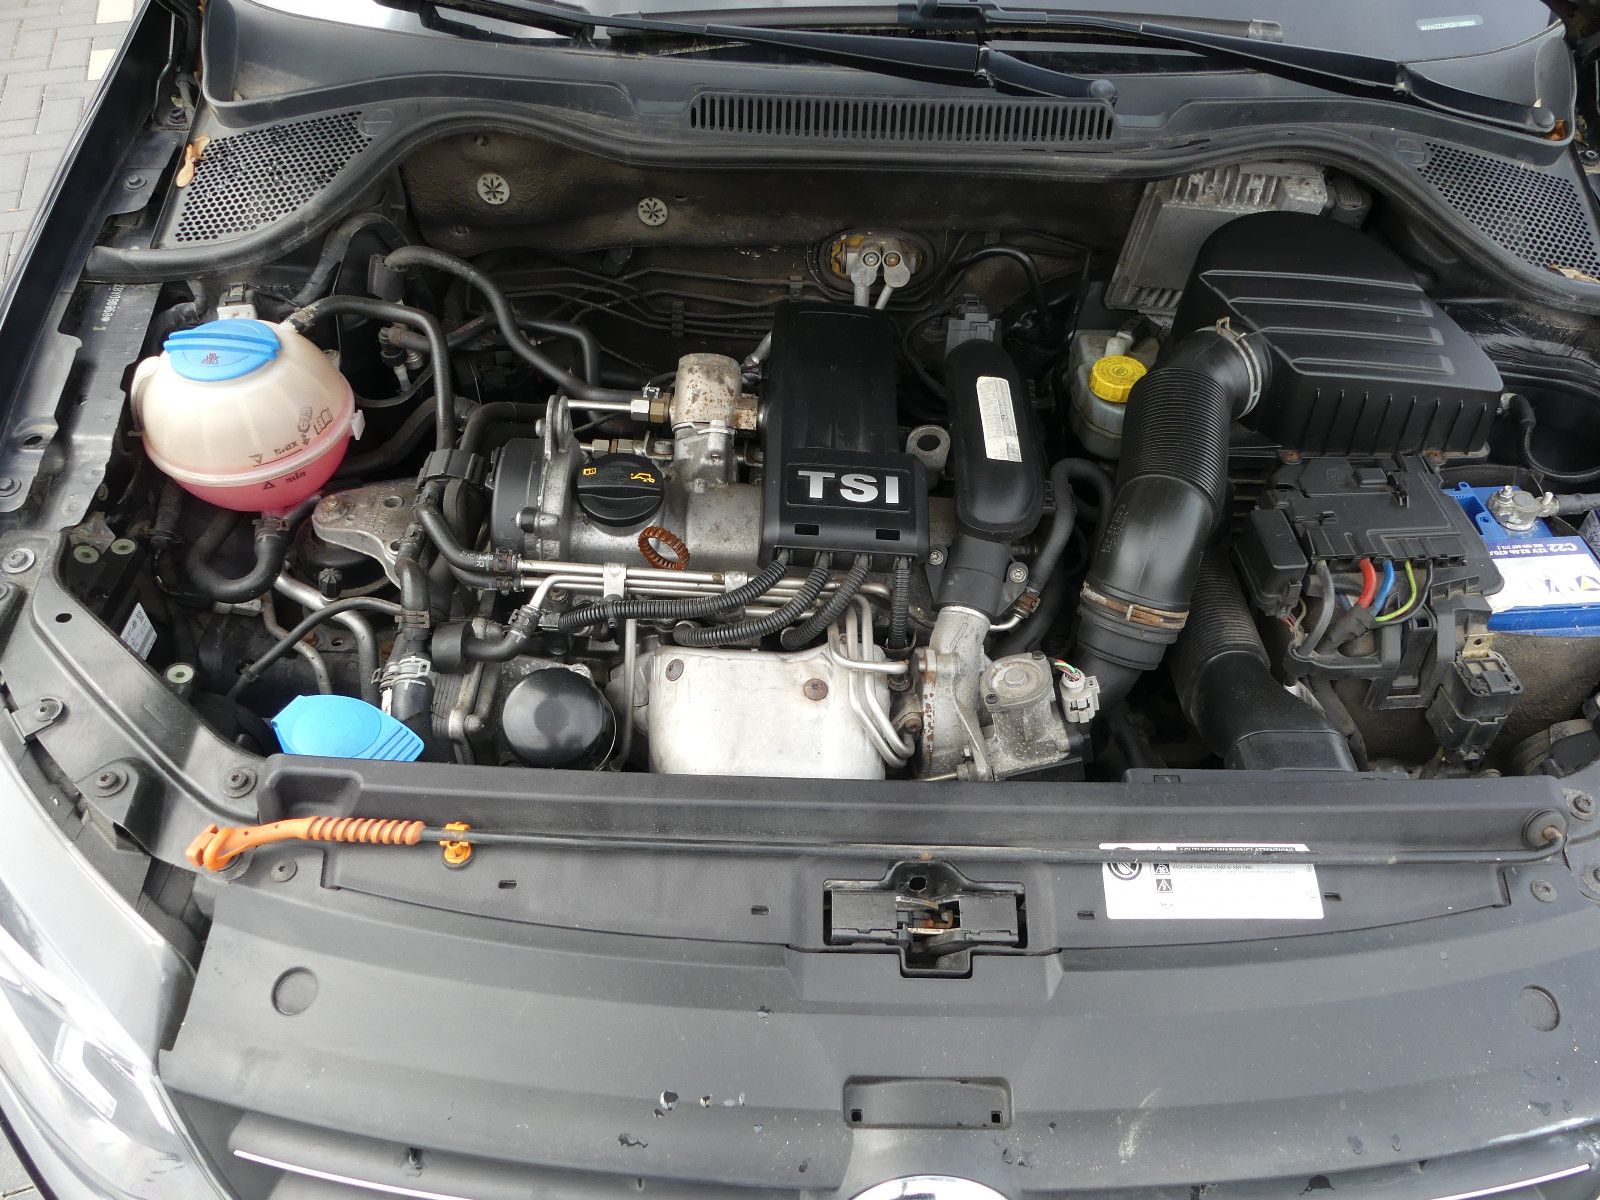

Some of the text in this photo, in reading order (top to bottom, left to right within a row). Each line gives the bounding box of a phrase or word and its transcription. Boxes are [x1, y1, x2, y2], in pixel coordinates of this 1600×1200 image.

[286, 471, 306, 483] min
[798, 470, 899, 504] TSI
[1546, 542, 1578, 553] C22
